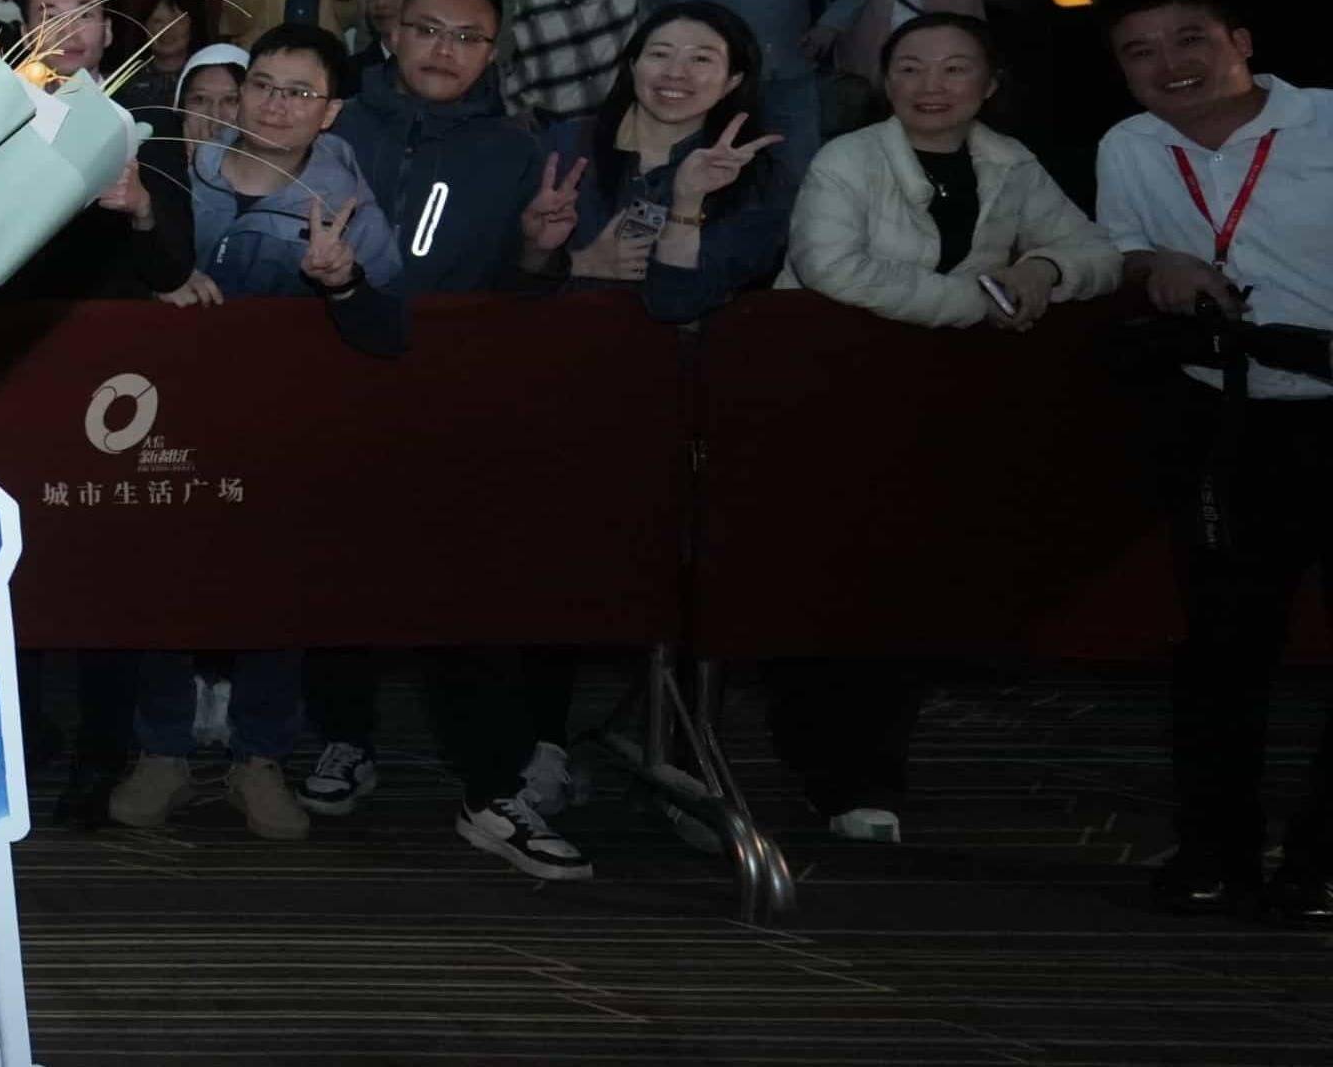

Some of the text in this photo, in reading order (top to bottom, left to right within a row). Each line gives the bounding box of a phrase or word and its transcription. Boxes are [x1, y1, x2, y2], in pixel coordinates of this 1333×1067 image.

[42, 477, 245, 507] 城市生活广场
